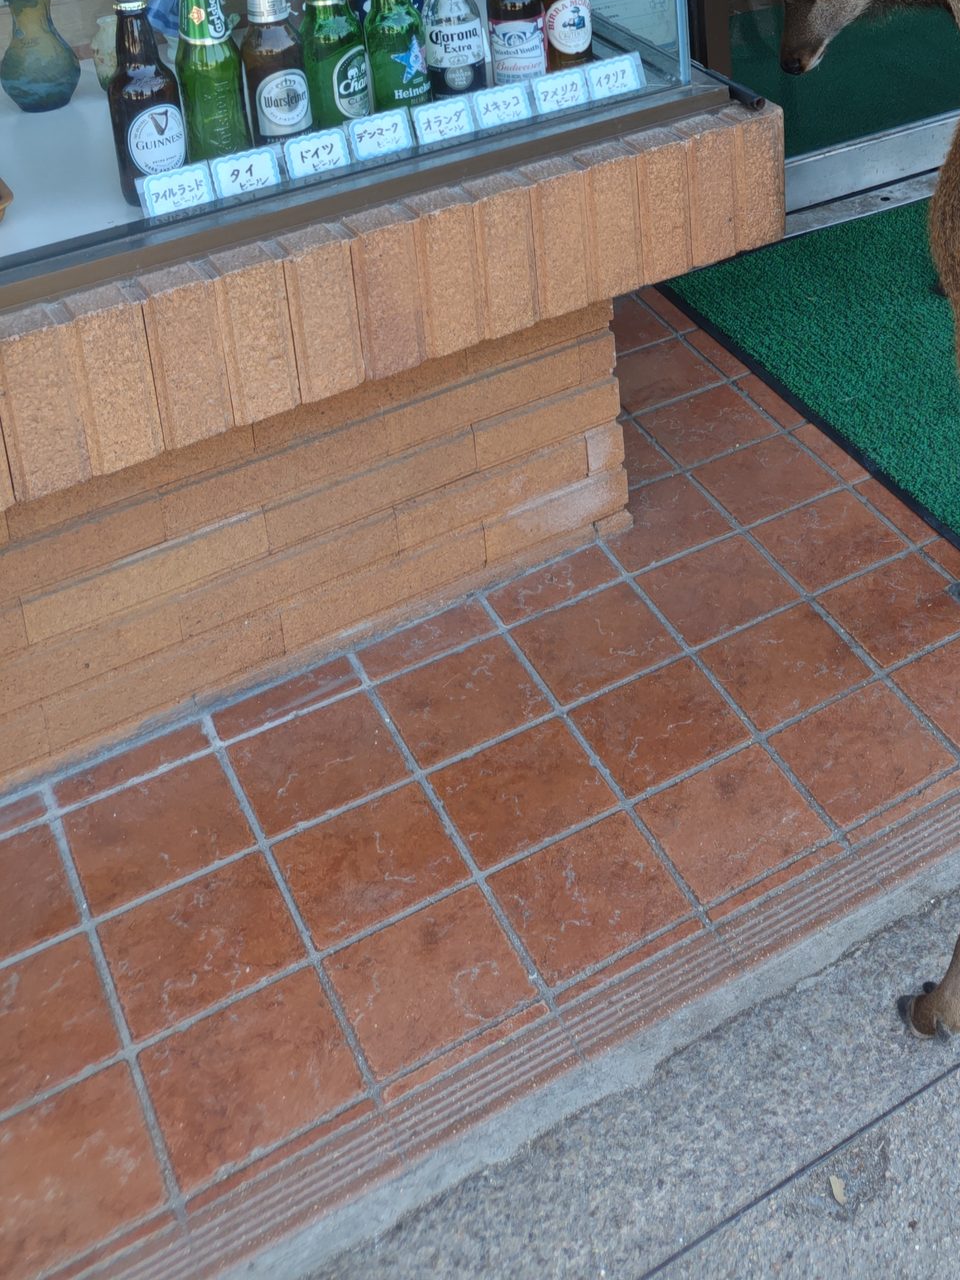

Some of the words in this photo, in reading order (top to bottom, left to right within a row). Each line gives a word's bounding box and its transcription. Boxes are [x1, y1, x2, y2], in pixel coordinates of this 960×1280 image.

[549, 4, 568, 30] BIRRA
[429, 27, 479, 47] Corona
[444, 44, 472, 54] Extra
[496, 61, 542, 72] Budweiser
[595, 69, 626, 87] イタリア
[263, 89, 307, 110] Warsteiner
[541, 81, 578, 102] アメリカ
[482, 96, 520, 115] メキシコ
[424, 108, 465, 131] オランダ
[356, 122, 399, 143] デンマーク
[439, 123, 465, 137] ビール
[135, 132, 183, 151] GUINNESS
[300, 143, 334, 165] ドイツ
[230, 164, 254, 184] タイ
[312, 157, 341, 172] ビール
[151, 178, 204, 204] アイルランド
[240, 176, 270, 192] ビール
[172, 191, 205, 208] ビール
